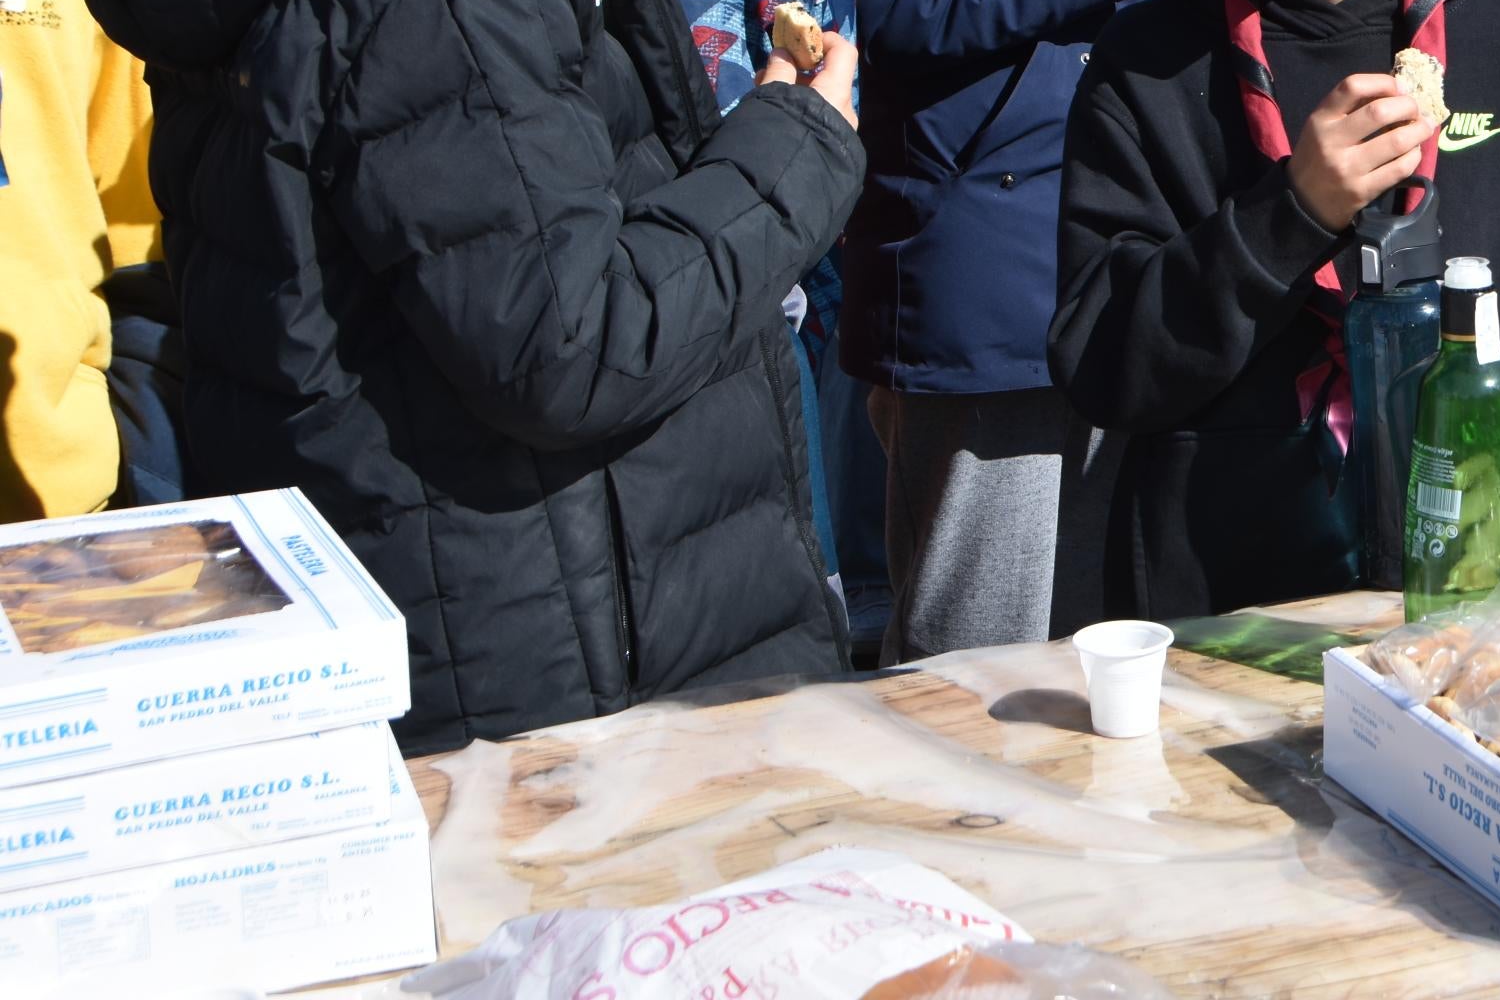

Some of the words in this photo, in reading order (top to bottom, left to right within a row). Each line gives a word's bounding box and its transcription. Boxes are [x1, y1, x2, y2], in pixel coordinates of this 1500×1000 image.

[1448, 113, 1494, 136] NIKE
[136, 683, 234, 713] GUERRA
[242, 669, 312, 694] RECIO
[320, 661, 360, 680] S.L.
[138, 714, 166, 729] SAN
[170, 706, 214, 724] PEDRO
[218, 700, 245, 714] DEL
[249, 692, 290, 709] VALLE
[1423, 770, 1446, 802] S.L.
[1442, 763, 1468, 789] VALLE
[1468, 776, 1486, 802] DEL
[113, 791, 211, 822] GUERRA
[221, 777, 292, 803] RECIO
[300, 770, 341, 789] S.L.
[116, 824, 143, 838] SAN
[147, 815, 193, 833] PEDRO
[198, 810, 223, 824] DEL
[228, 801, 270, 818] VALLE
[1449, 793, 1492, 835] RECIO
[174, 860, 277, 890] HOJALDRES
